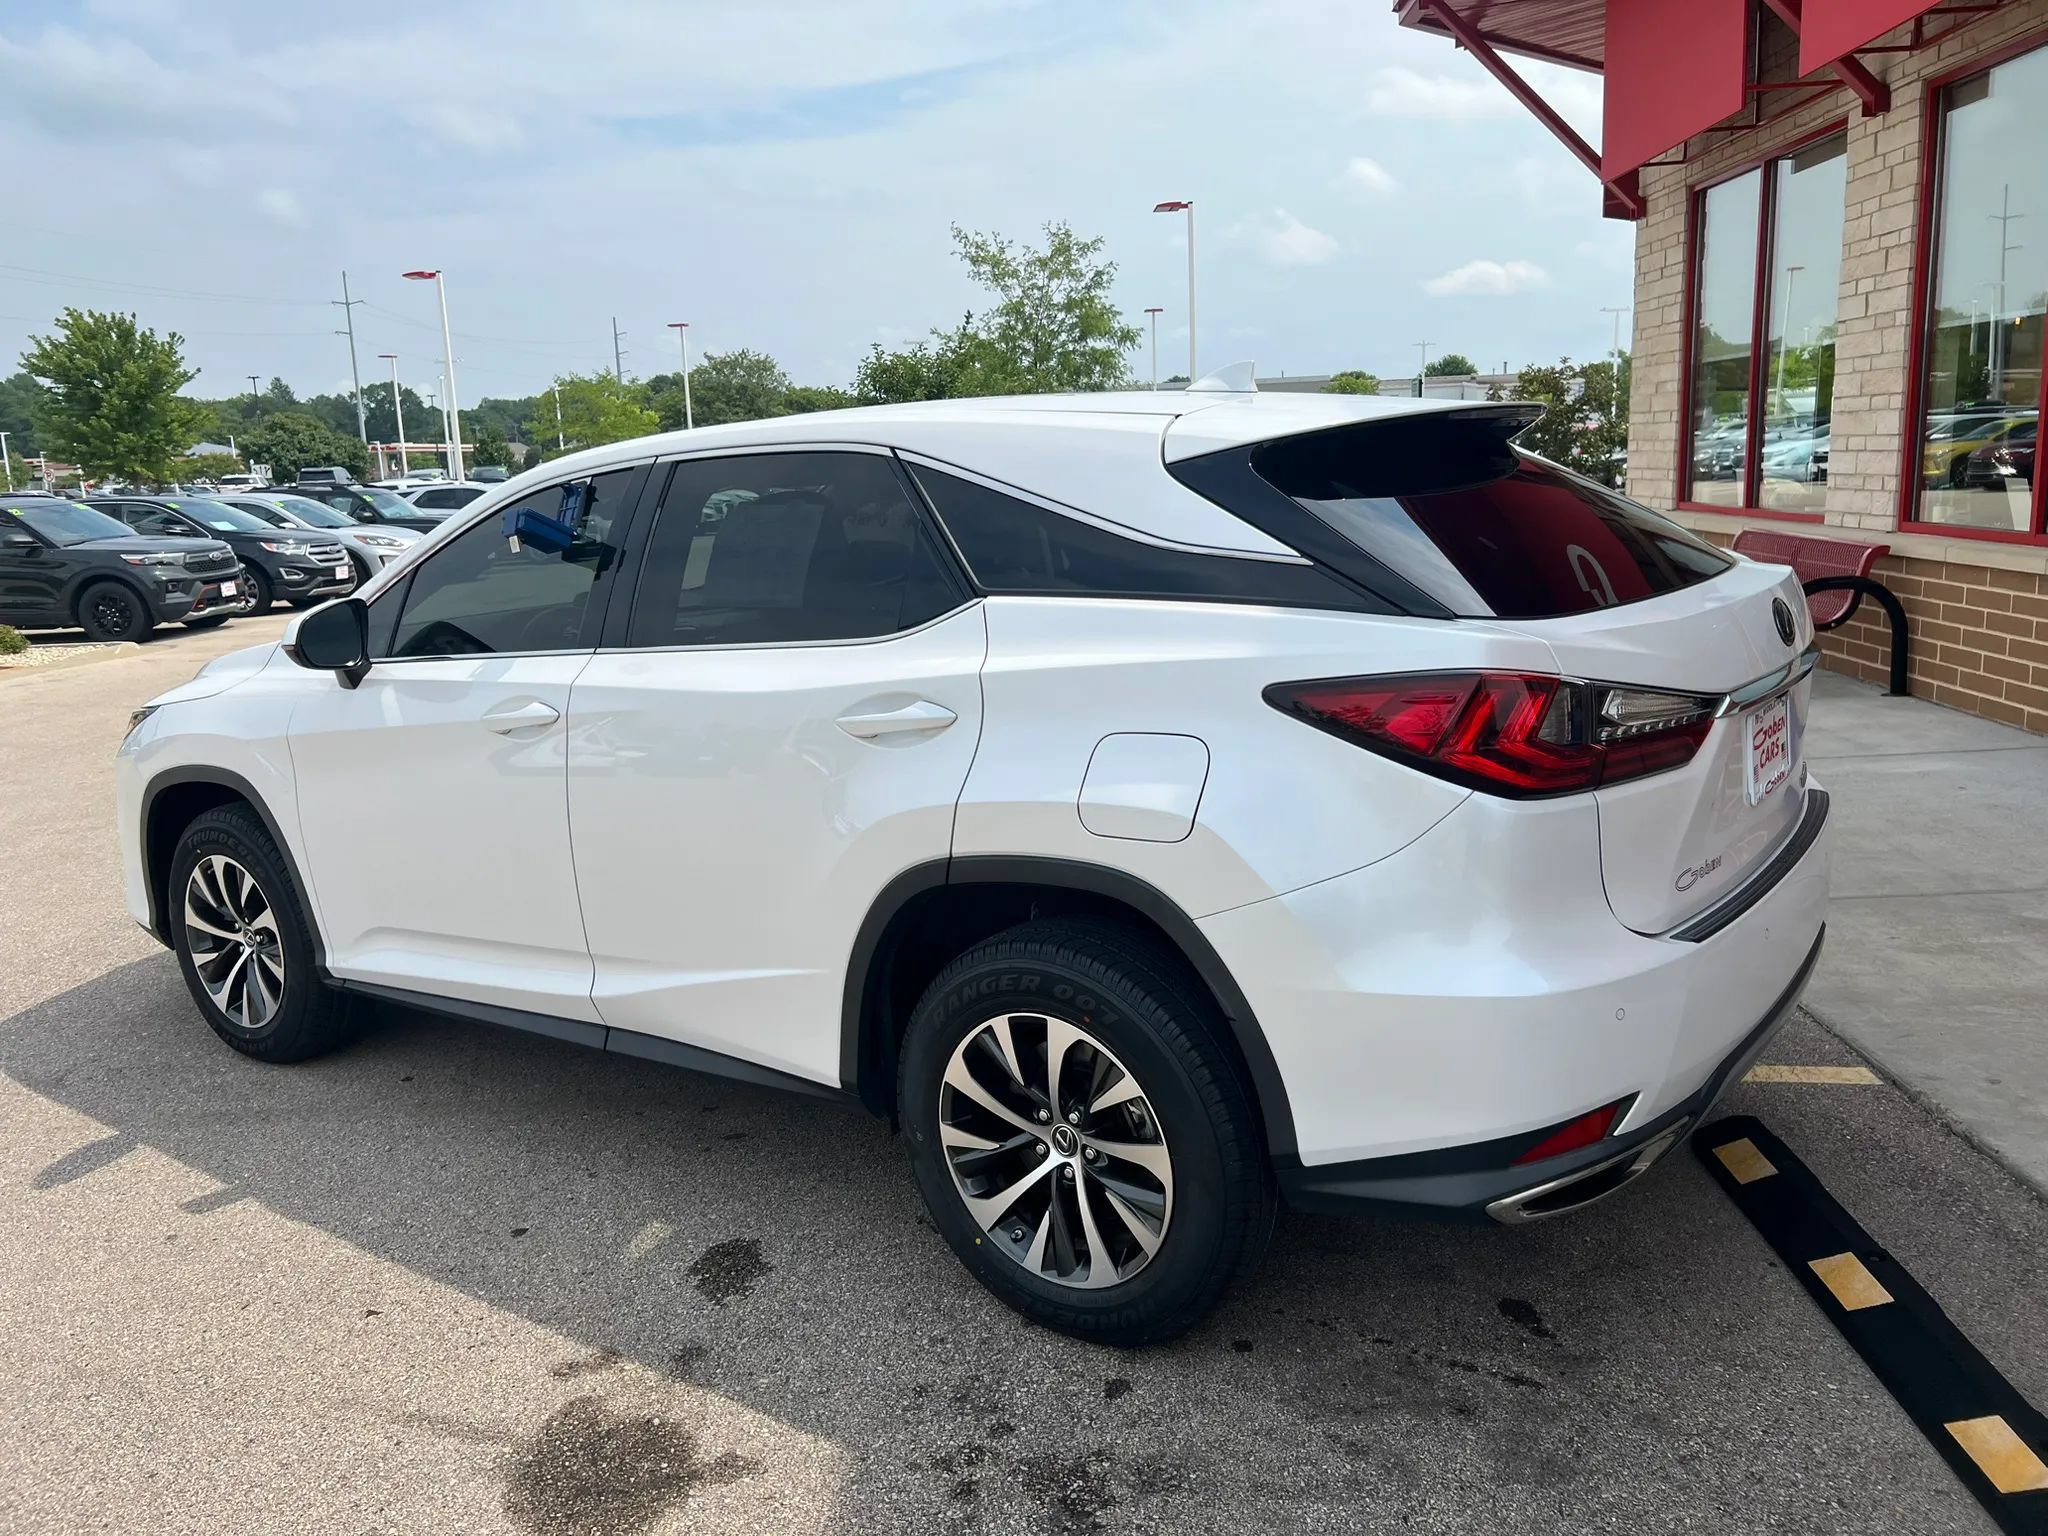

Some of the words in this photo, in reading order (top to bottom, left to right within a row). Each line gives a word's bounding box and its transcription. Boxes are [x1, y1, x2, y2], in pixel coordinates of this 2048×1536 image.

[1760, 737, 1780, 769] CARS
[934, 974, 1041, 1028] RANGER
[1053, 984, 1119, 1023] 007
